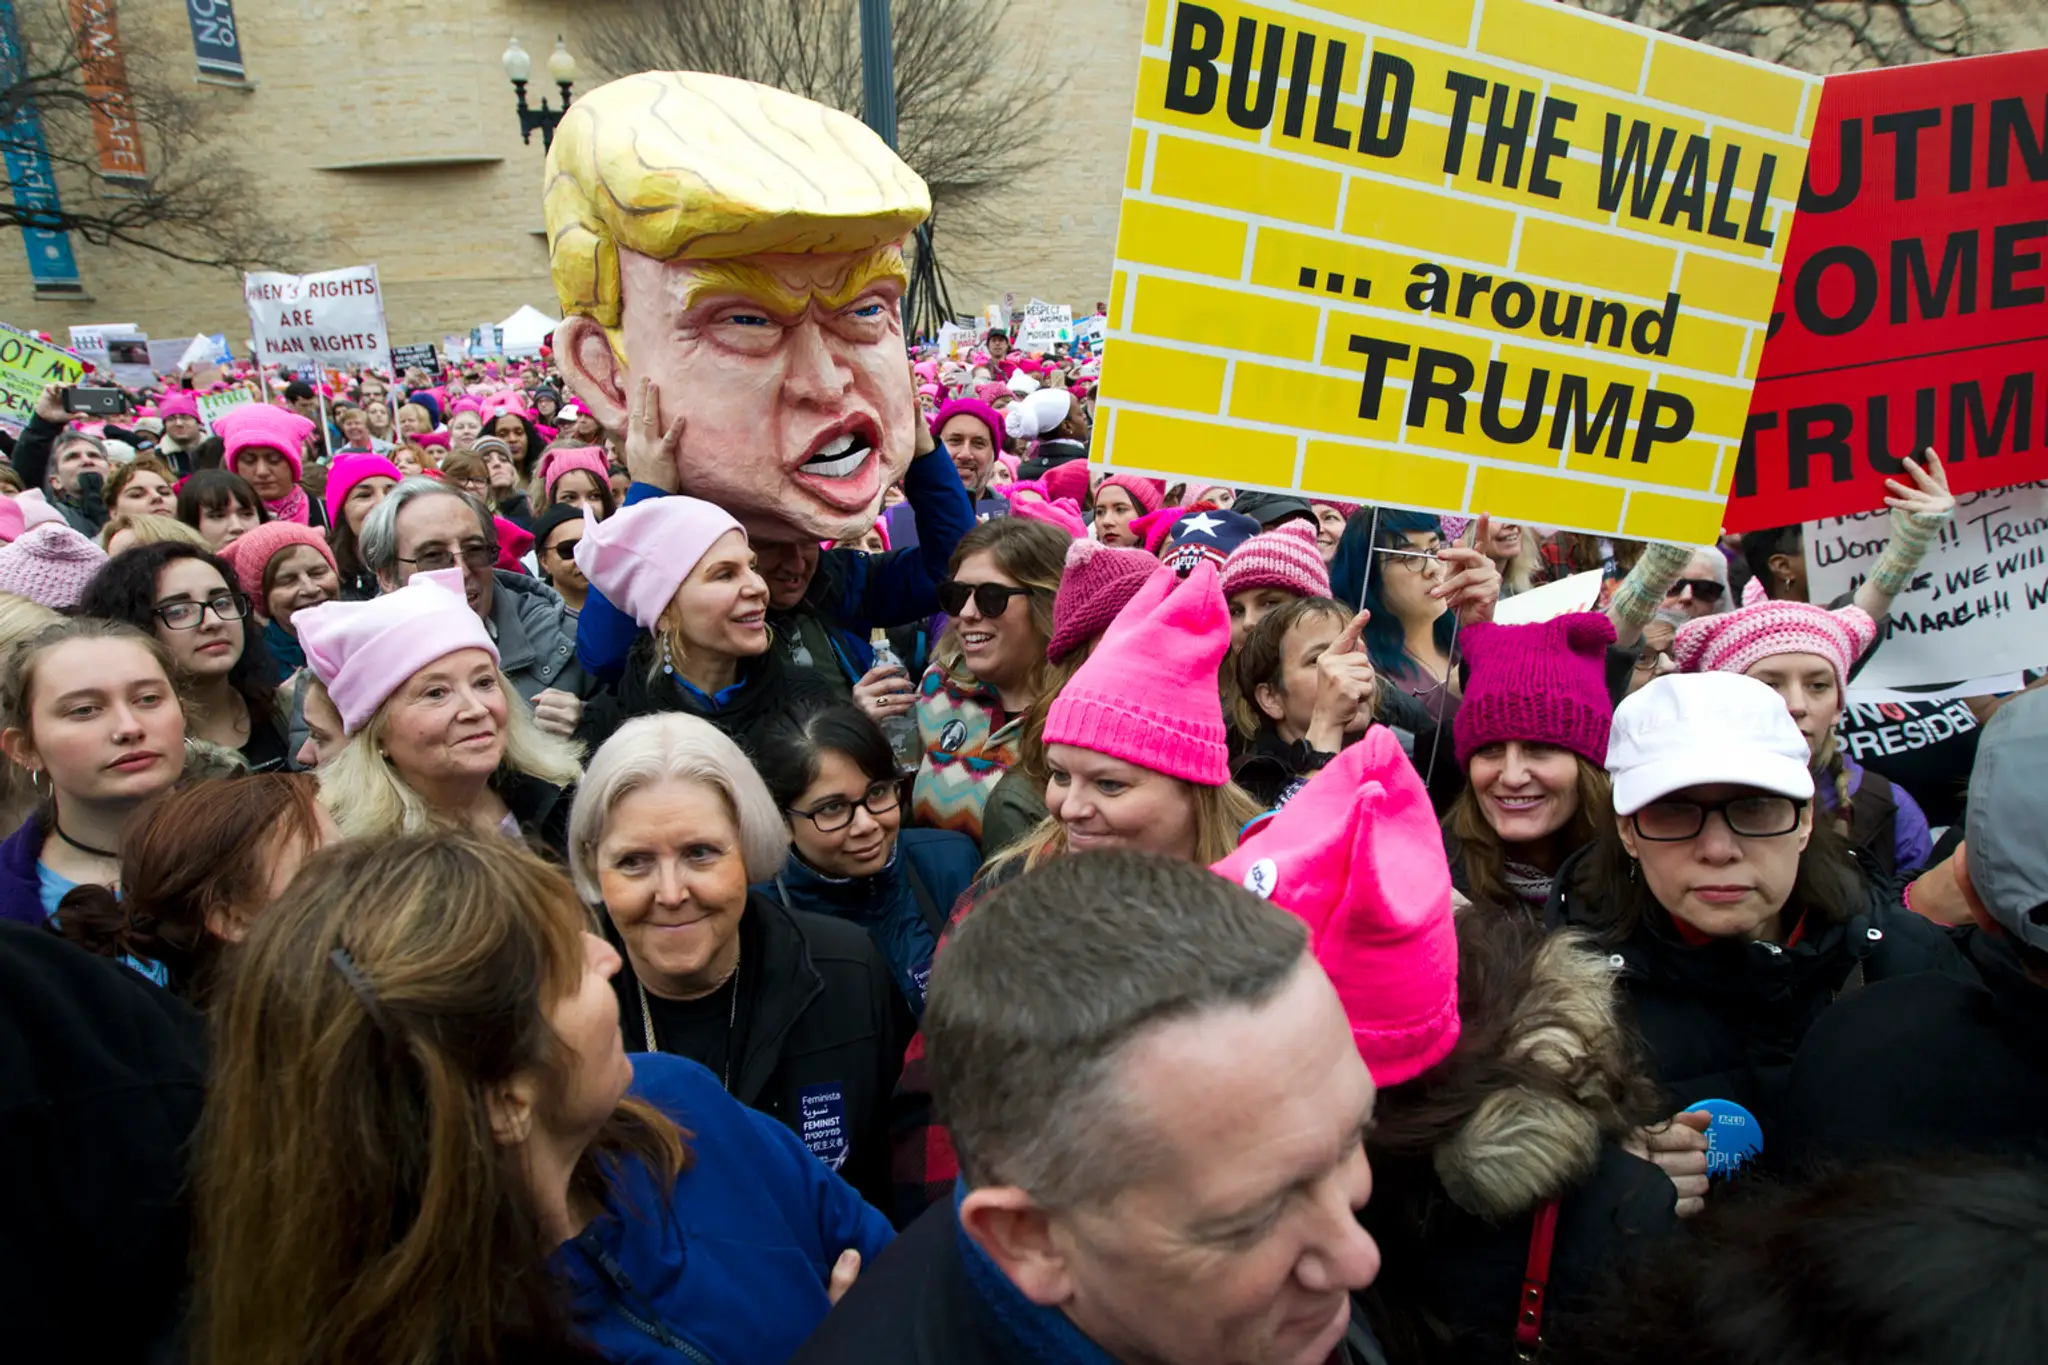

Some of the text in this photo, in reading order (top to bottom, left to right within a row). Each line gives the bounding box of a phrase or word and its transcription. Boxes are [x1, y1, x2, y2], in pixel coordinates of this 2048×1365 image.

[1164, 1, 1777, 248] BUILD THE WALL
[309, 278, 375, 298] RIGHTS
[281, 309, 314, 327] ARE
[1405, 263, 1681, 357] around
[310, 333, 377, 352] RIGHTS
[0, 338, 82, 383] OT MY
[1348, 334, 1695, 464] TRUMP
[1735, 372, 2048, 497] TRUM
[1815, 535, 1890, 567] Wom
[1946, 563, 1991, 595] WE
[802, 1092, 841, 1105] Feminista
[803, 1116, 840, 1131] FEMINIST
